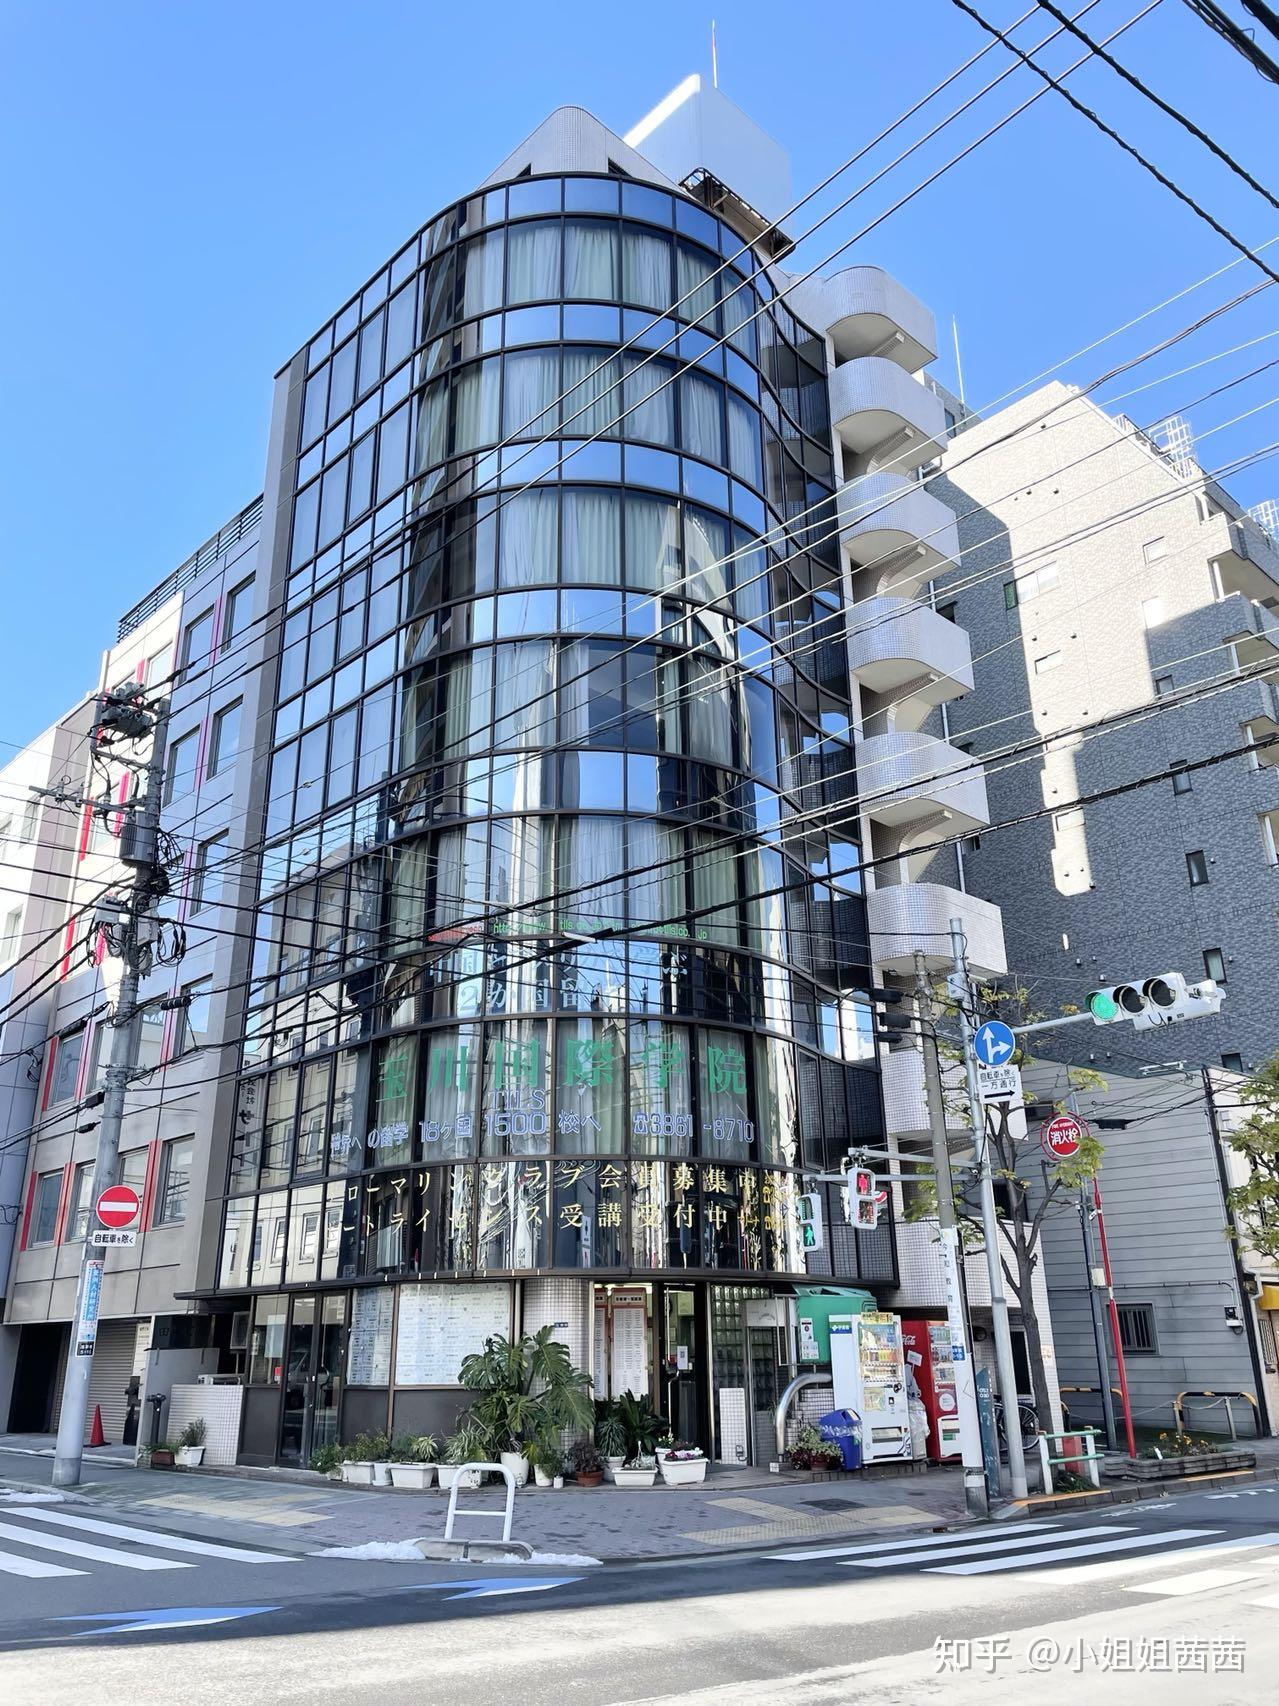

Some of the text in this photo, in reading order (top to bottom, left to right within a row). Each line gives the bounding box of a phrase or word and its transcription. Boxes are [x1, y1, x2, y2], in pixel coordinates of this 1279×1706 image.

[981, 1080, 1017, 1090] 一方通行
[1050, 1127, 1079, 1146] 消火栓
[94, 1233, 134, 1244] 自転車を除く
